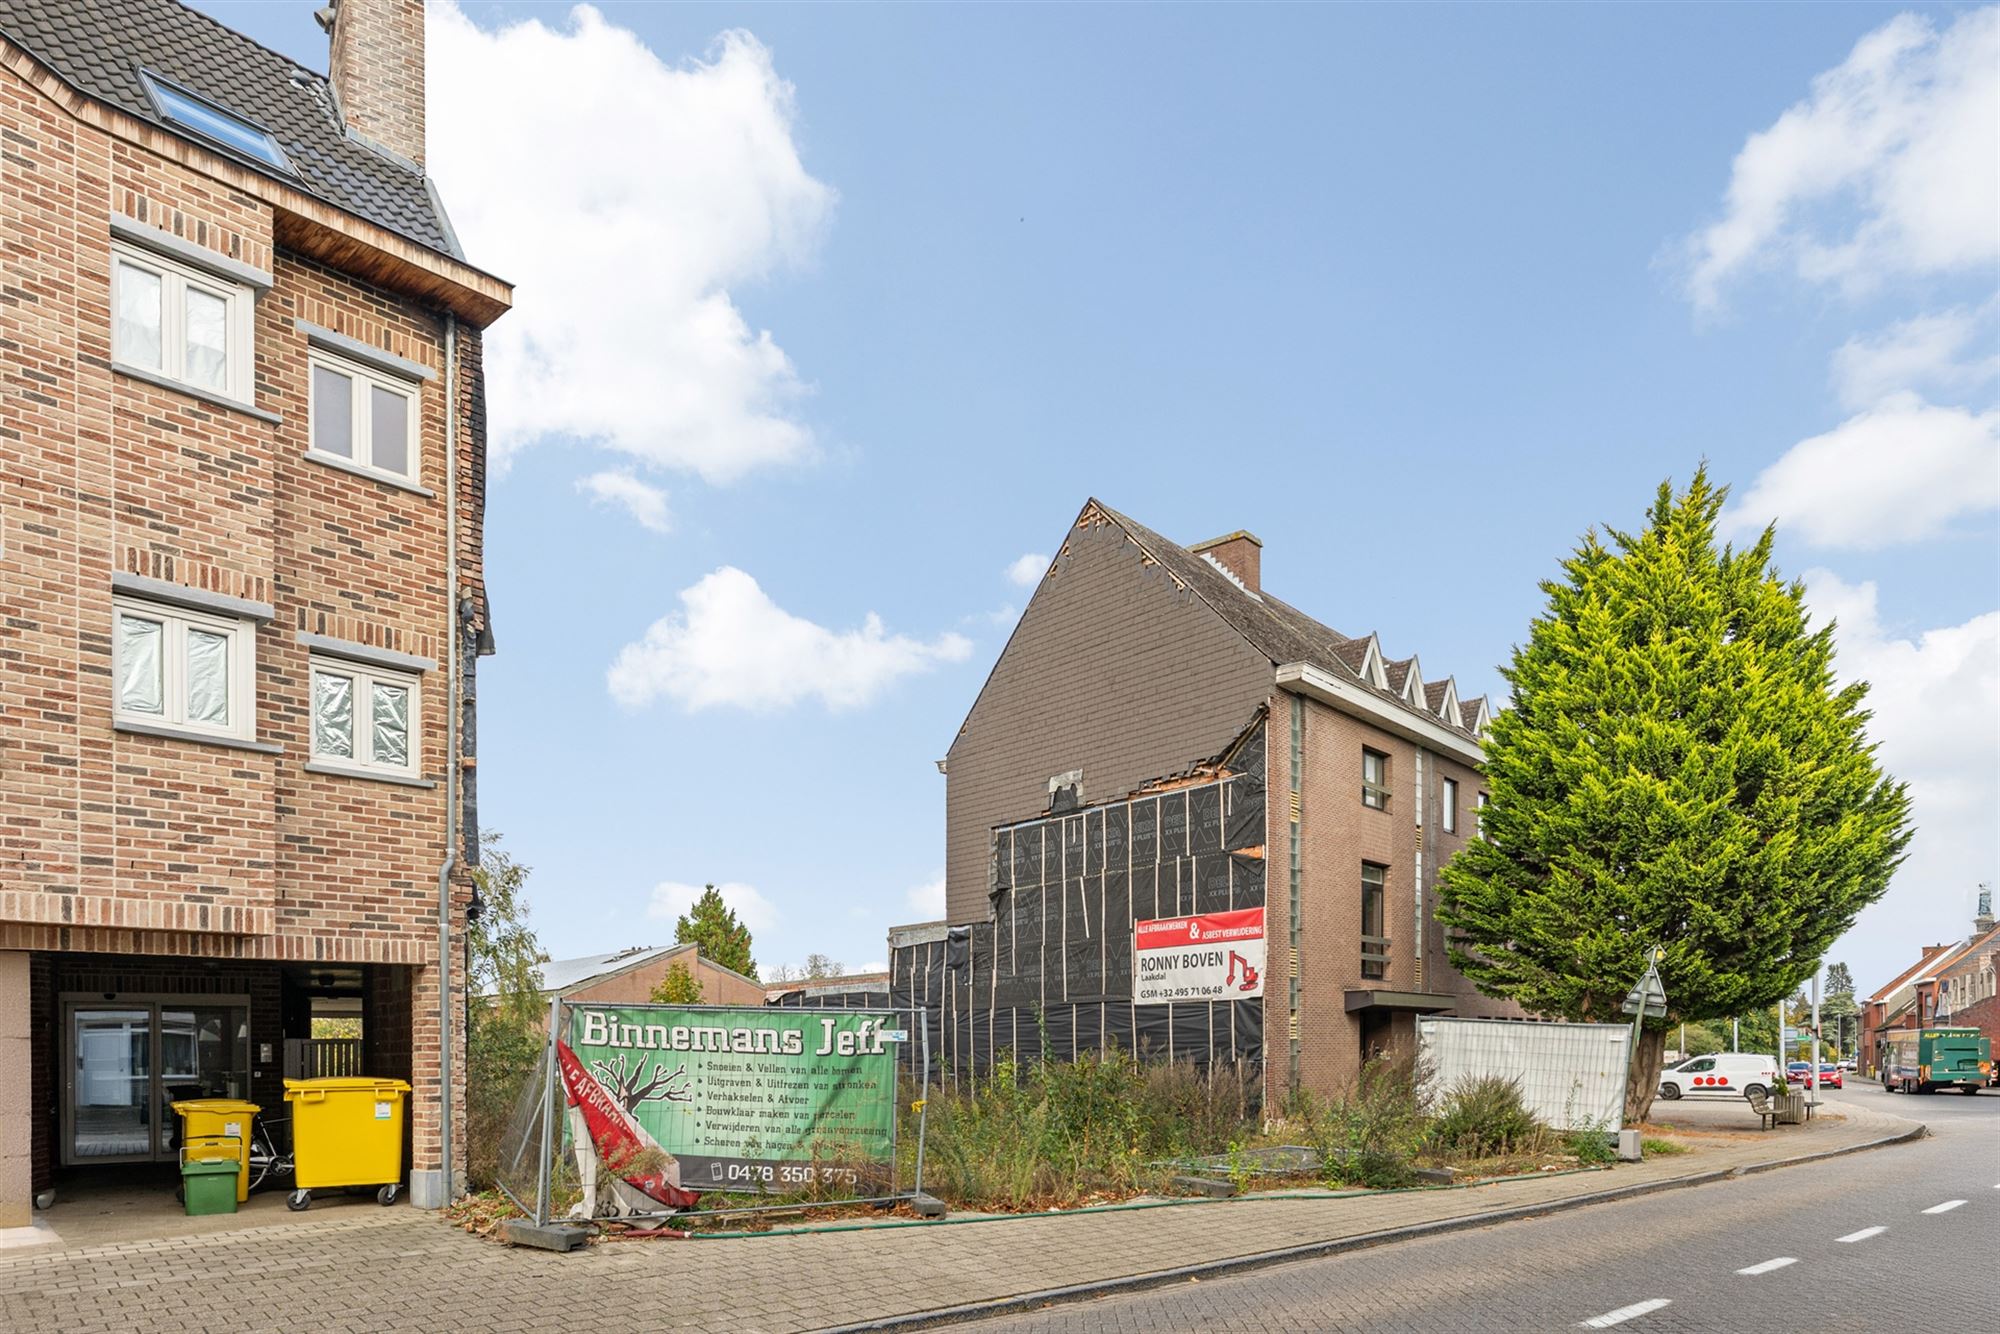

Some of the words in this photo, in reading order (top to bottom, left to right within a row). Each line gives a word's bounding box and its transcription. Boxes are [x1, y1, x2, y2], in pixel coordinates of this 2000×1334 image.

[1138, 925, 1148, 933] ALLE
[1190, 922, 1200, 939] &
[1202, 931, 1221, 940] ASBEST
[1141, 955, 1180, 972] RONNY
[1182, 951, 1223, 969] BOVEN
[1141, 972, 1166, 982] Laakdal
[1140, 989, 1157, 998] GSM
[1159, 988, 1173, 997] +32
[1174, 987, 1189, 996] 495
[1191, 987, 1199, 995] 71
[1201, 986, 1211, 995] 06
[1212, 985, 1223, 994] 48
[581, 1011, 803, 1056] Binnemans
[816, 1016, 886, 1057] Jeff
[707, 1061, 742, 1072] Snoeien
[745, 1063, 753, 1073] &
[758, 1063, 786, 1074] Vellen
[811, 1065, 829, 1075] alle
[707, 1076, 751, 1088] Uitgraven
[755, 1079, 762, 1087] &
[767, 1079, 809, 1090] Uitfrezen
[832, 1080, 877, 1091] stronken
[707, 1091, 763, 1103] Verhakselen
[767, 1093, 774, 1103] &
[778, 1094, 809, 1105] Afvoer
[706, 1106, 755, 1117] Bouwklaar
[759, 1109, 790, 1118] maken
[794, 1112, 810, 1120] van
[705, 1120, 760, 1133] Verwijderen
[764, 1125, 781, 1133] van
[785, 1124, 801, 1134] alle
[704, 1136, 740, 1147] Scheren
[765, 1140, 793, 1151] hagen
[728, 1164, 773, 1182] 0478
[781, 1166, 813, 1183] 350
[822, 1167, 857, 1184] 375
